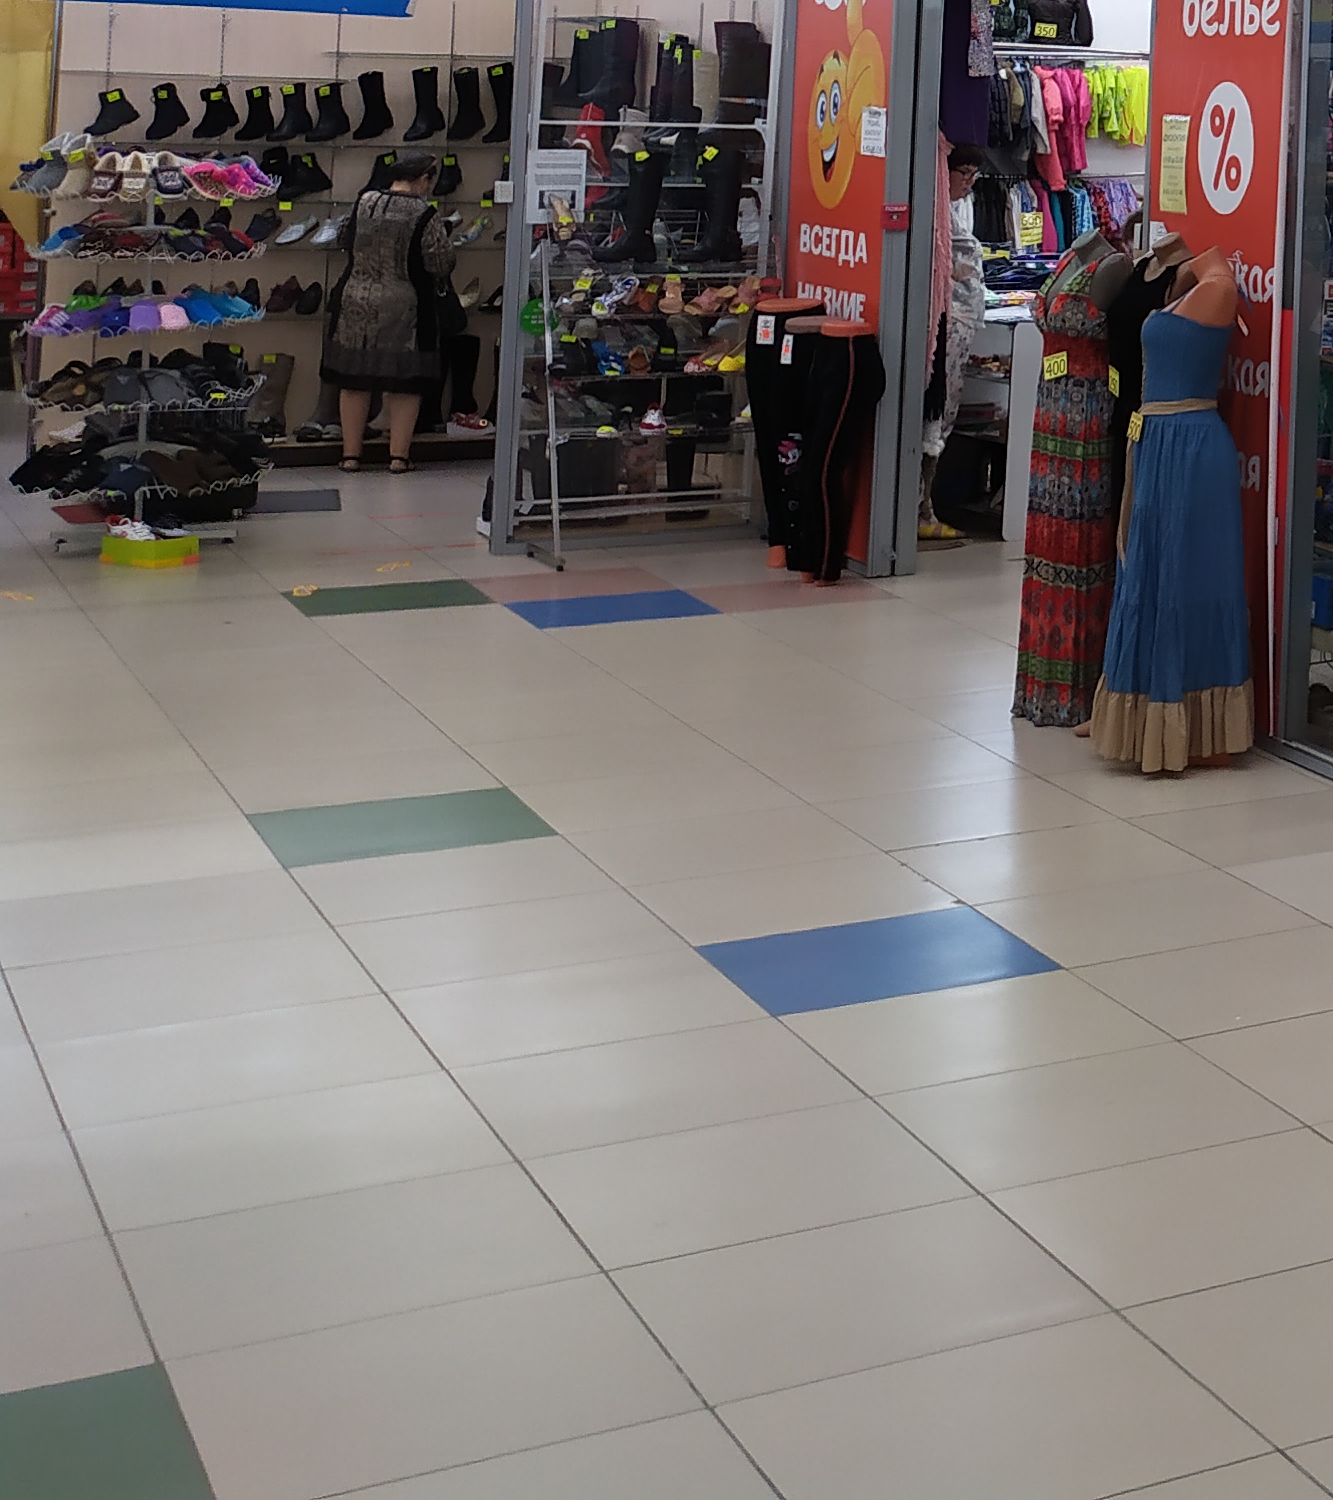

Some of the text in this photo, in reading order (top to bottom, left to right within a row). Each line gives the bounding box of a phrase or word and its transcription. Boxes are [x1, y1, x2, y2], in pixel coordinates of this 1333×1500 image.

[1036, 25, 1055, 37] 350
[800, 223, 868, 269] ВСЕГДА
[1045, 358, 1067, 378] 400
